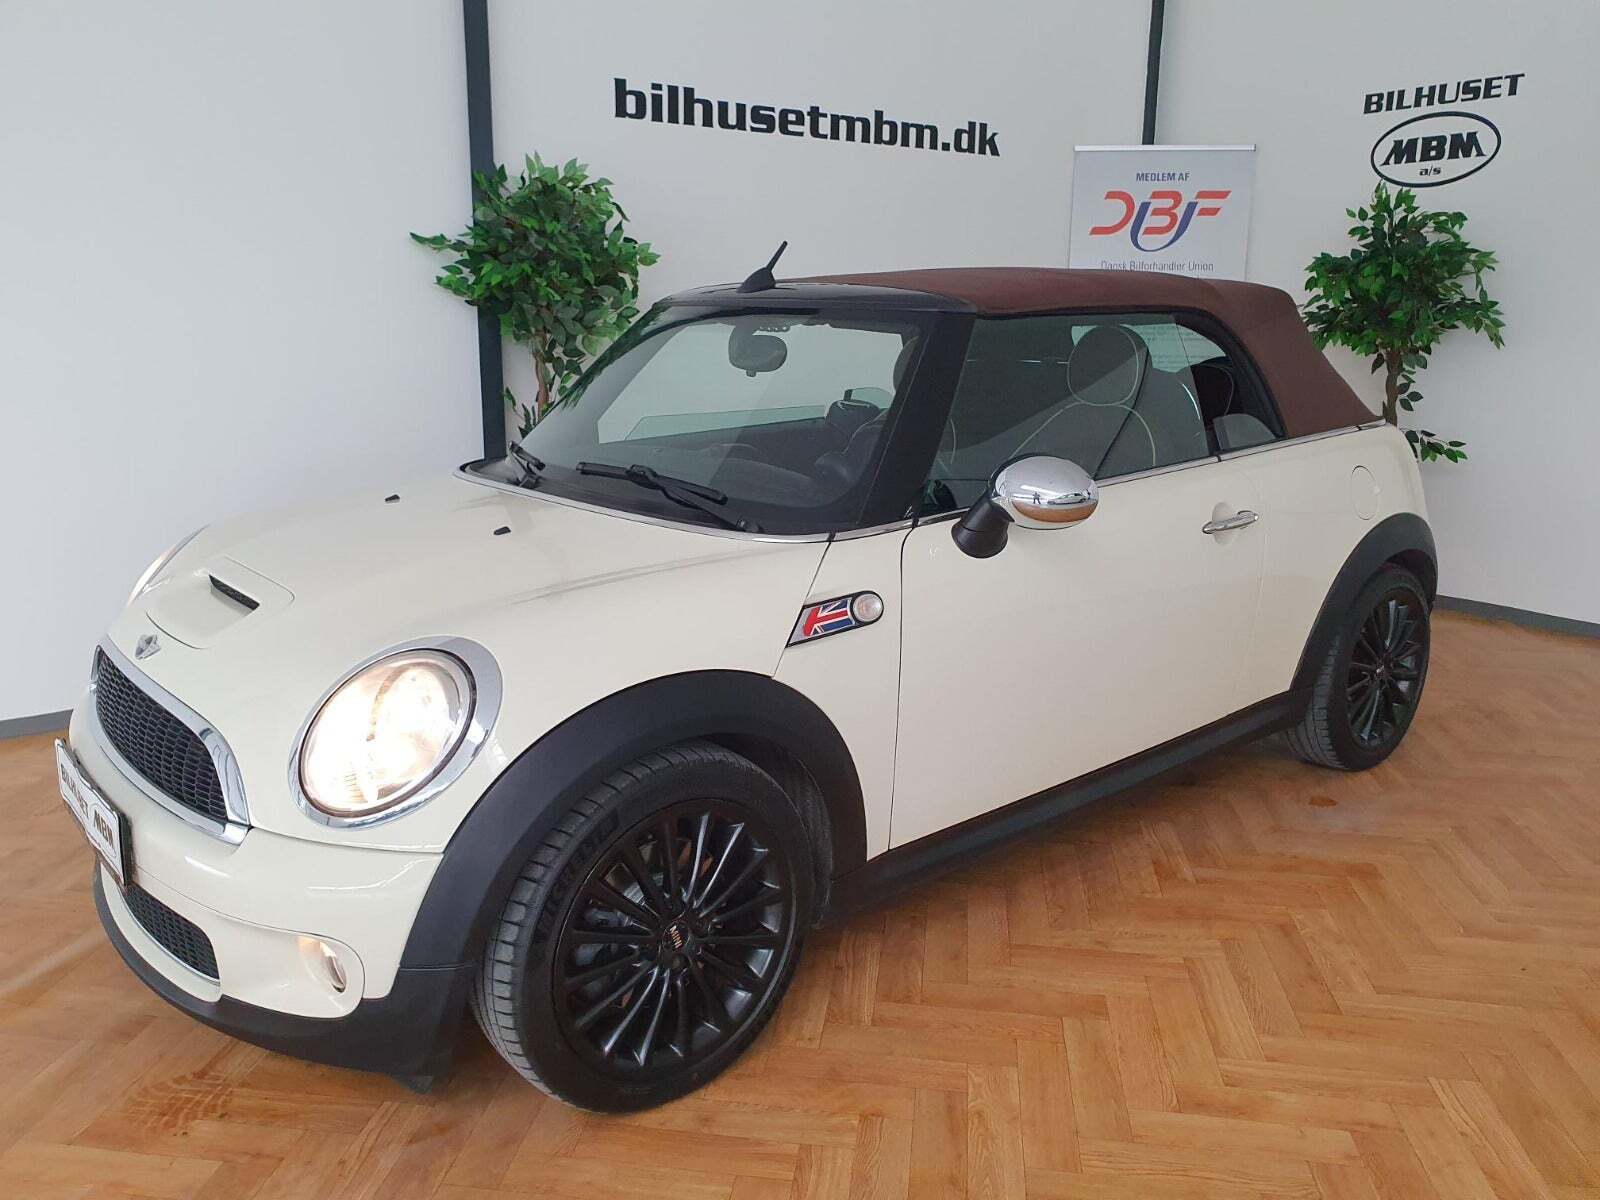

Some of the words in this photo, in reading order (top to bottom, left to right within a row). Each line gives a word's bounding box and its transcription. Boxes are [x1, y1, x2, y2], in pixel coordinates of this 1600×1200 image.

[1363, 73, 1525, 114] BILHUSET
[614, 77, 1000, 156] bilhusetmbm.dk
[1380, 131, 1487, 166] MBM
[1137, 173, 1175, 181] MEDLEM
[1178, 173, 1190, 181] AF
[1419, 165, 1441, 176] a/s
[1101, 261, 1127, 270] Dansk
[1130, 260, 1186, 271] Bilforhandler
[1189, 262, 1214, 272] Union
